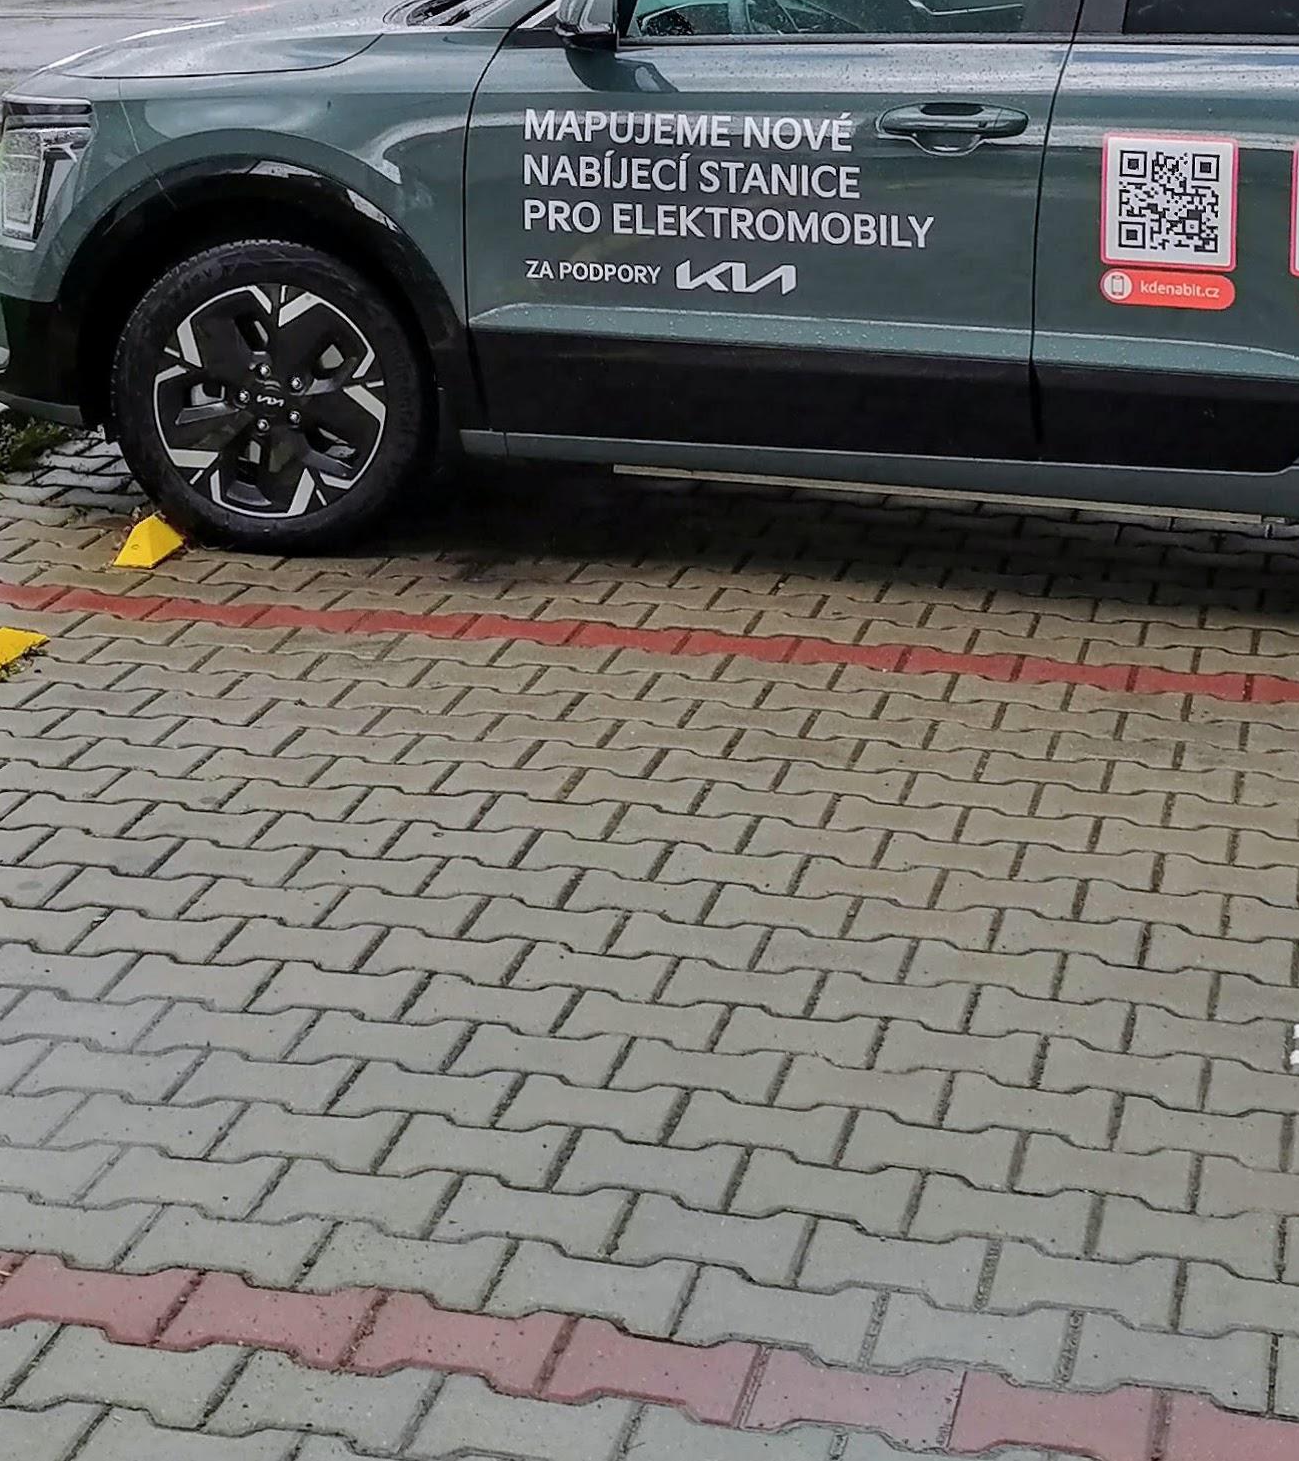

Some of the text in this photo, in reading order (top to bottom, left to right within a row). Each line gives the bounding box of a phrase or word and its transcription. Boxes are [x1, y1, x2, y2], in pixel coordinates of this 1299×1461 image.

[523, 108, 854, 153] MAPUJEME NOVÉ
[522, 150, 862, 200] NABÍJECÍ STANICE
[522, 199, 935, 249] PRO ELEKTROMOBILY
[524, 259, 555, 280] ZA
[559, 261, 662, 285] PODPORY
[1139, 280, 1221, 300] kdenabit.cz
